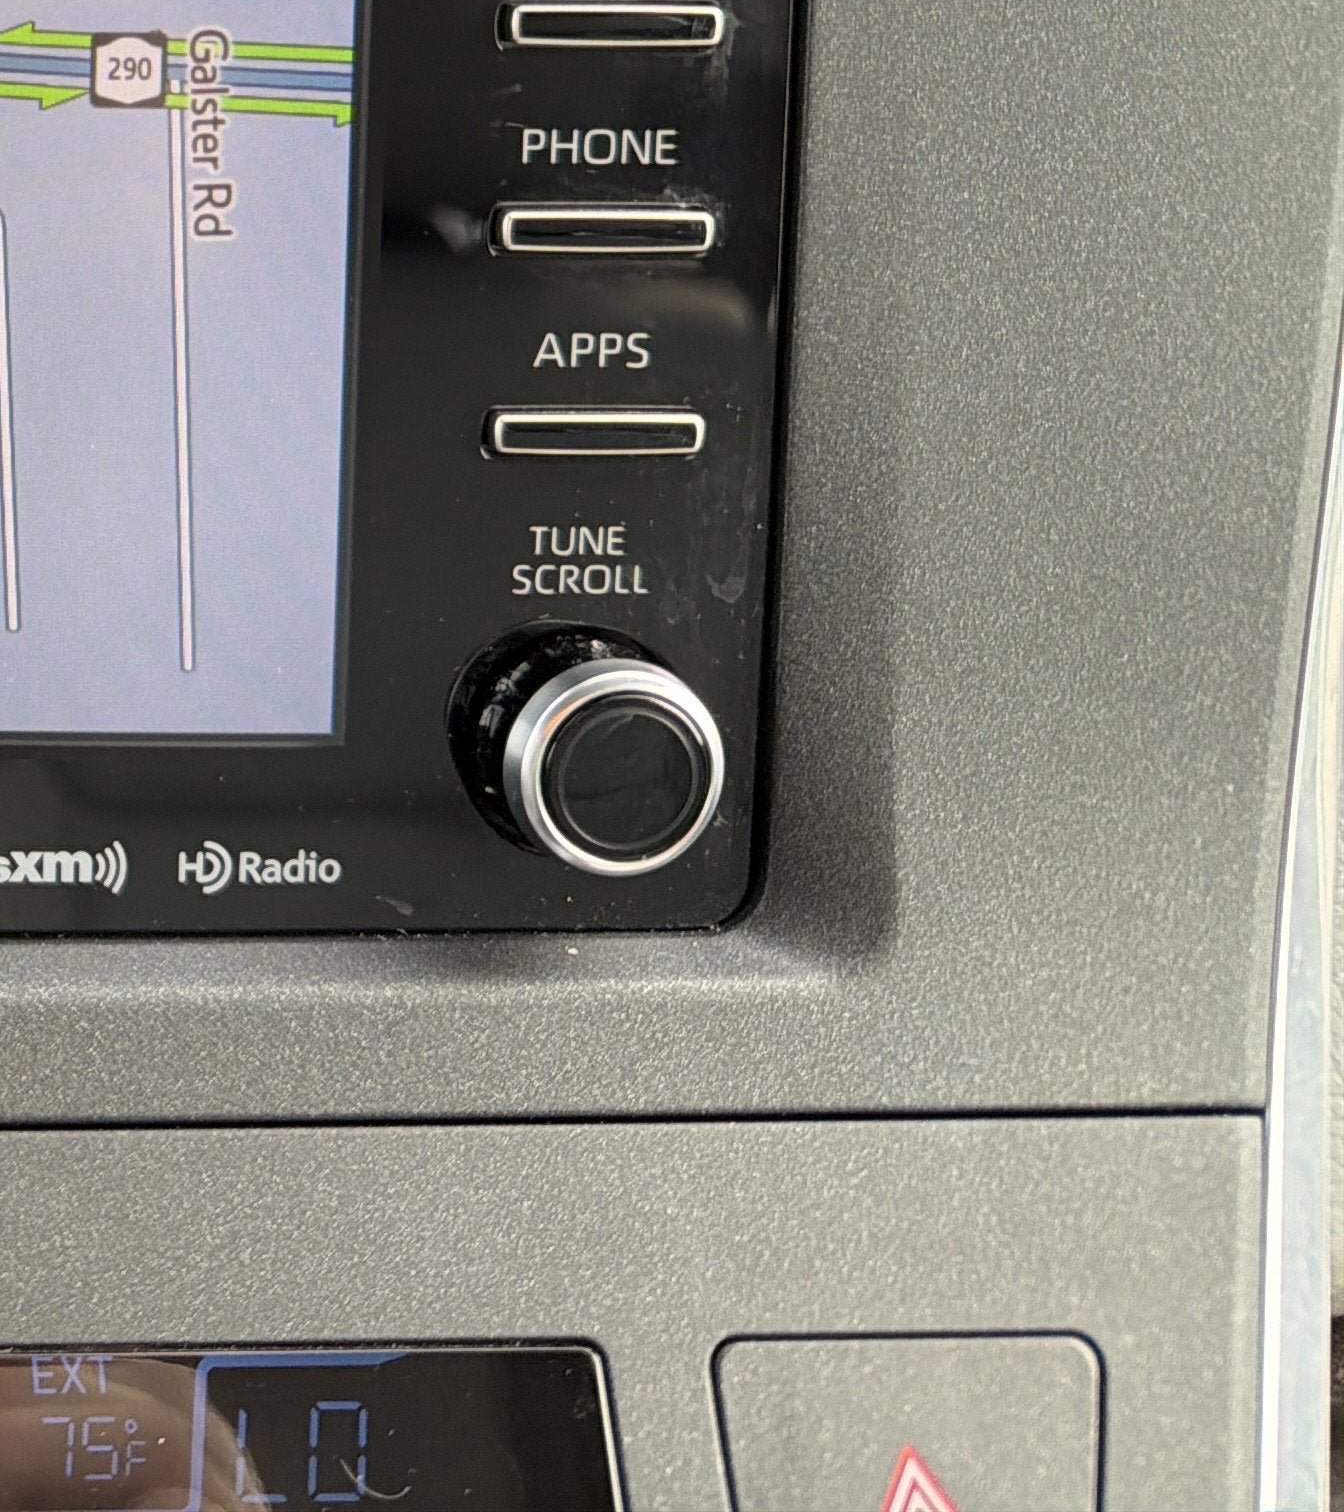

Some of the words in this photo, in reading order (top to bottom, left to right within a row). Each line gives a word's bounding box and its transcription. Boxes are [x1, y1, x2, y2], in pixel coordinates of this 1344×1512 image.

[108, 57, 152, 82] 290
[188, 29, 231, 172] Galster
[521, 128, 679, 166] PHONE
[192, 181, 233, 239] Rd
[533, 331, 650, 369] APPS
[529, 526, 625, 556] TUNE
[512, 563, 648, 595] SCROLL
[178, 841, 232, 894] HD
[239, 849, 341, 884] Radio
[31, 1356, 112, 1395] EXT
